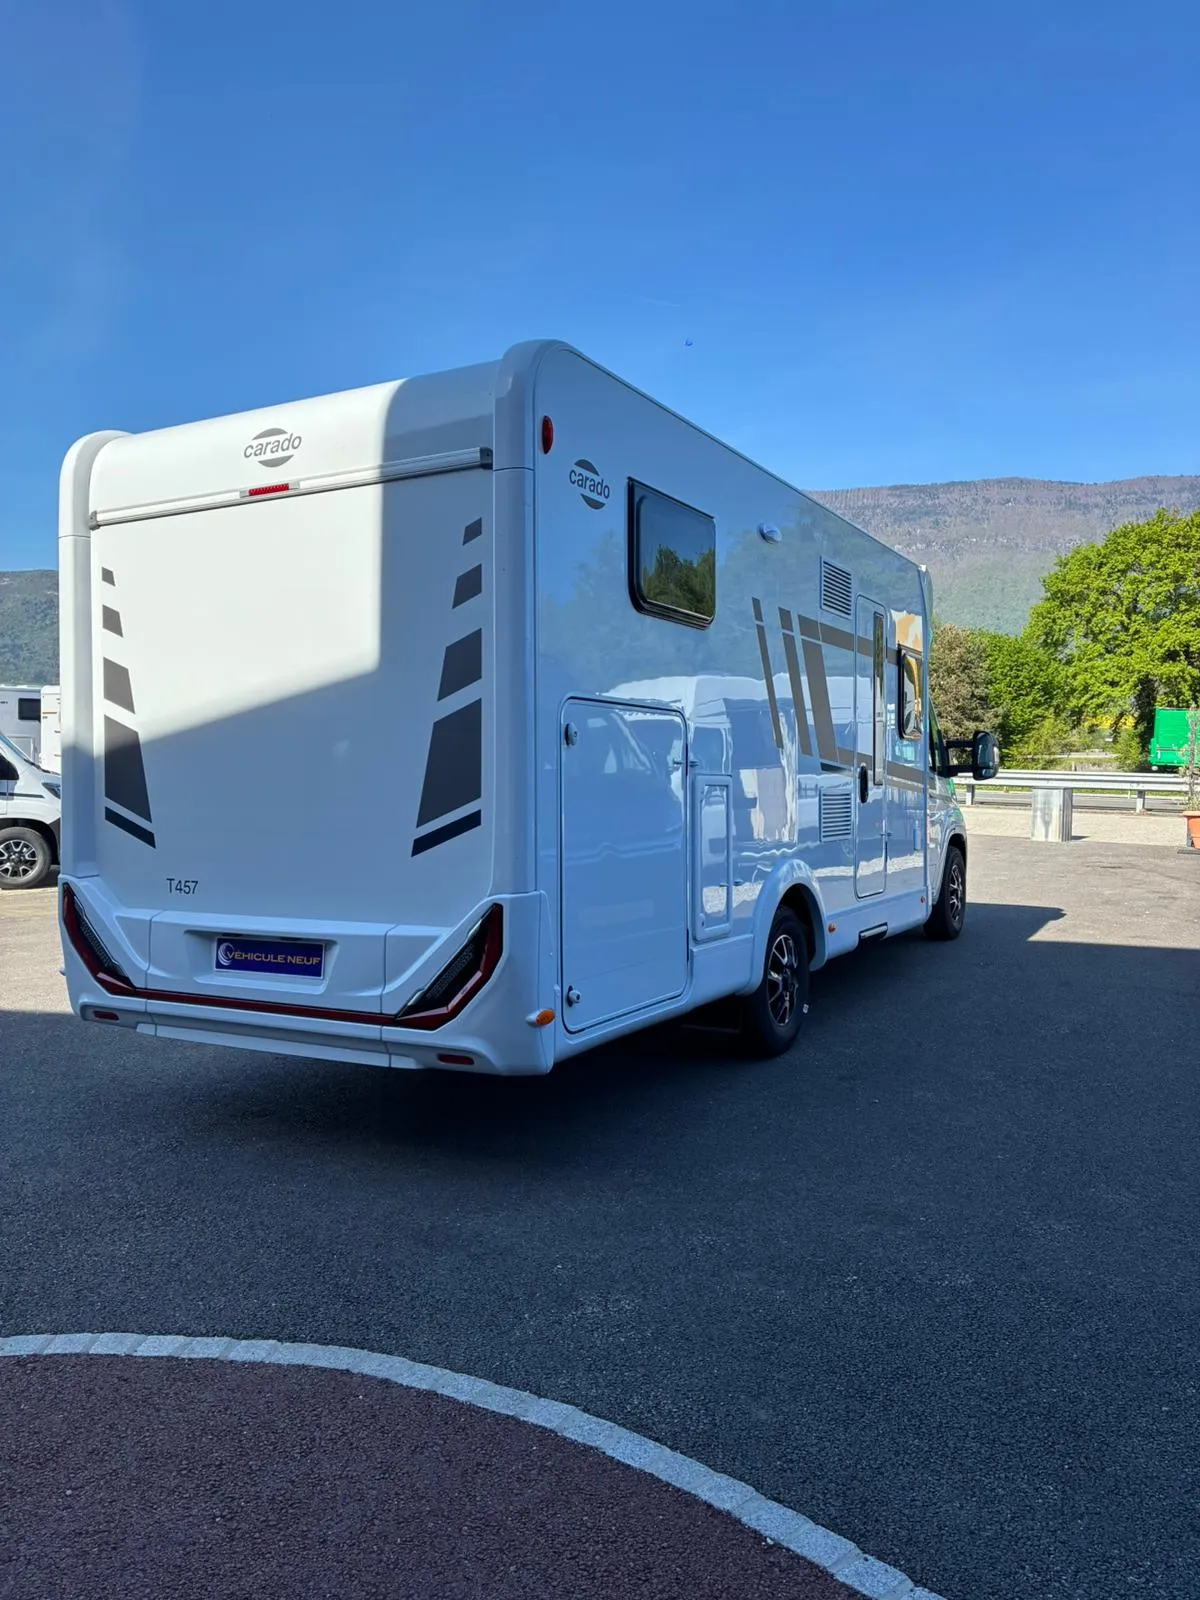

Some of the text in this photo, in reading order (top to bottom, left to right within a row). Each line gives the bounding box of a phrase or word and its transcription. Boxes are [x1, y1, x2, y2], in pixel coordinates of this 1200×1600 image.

[243, 432, 302, 459] carado
[569, 469, 610, 499] carado
[166, 878, 199, 895] T457
[287, 955, 321, 965] NEUF
